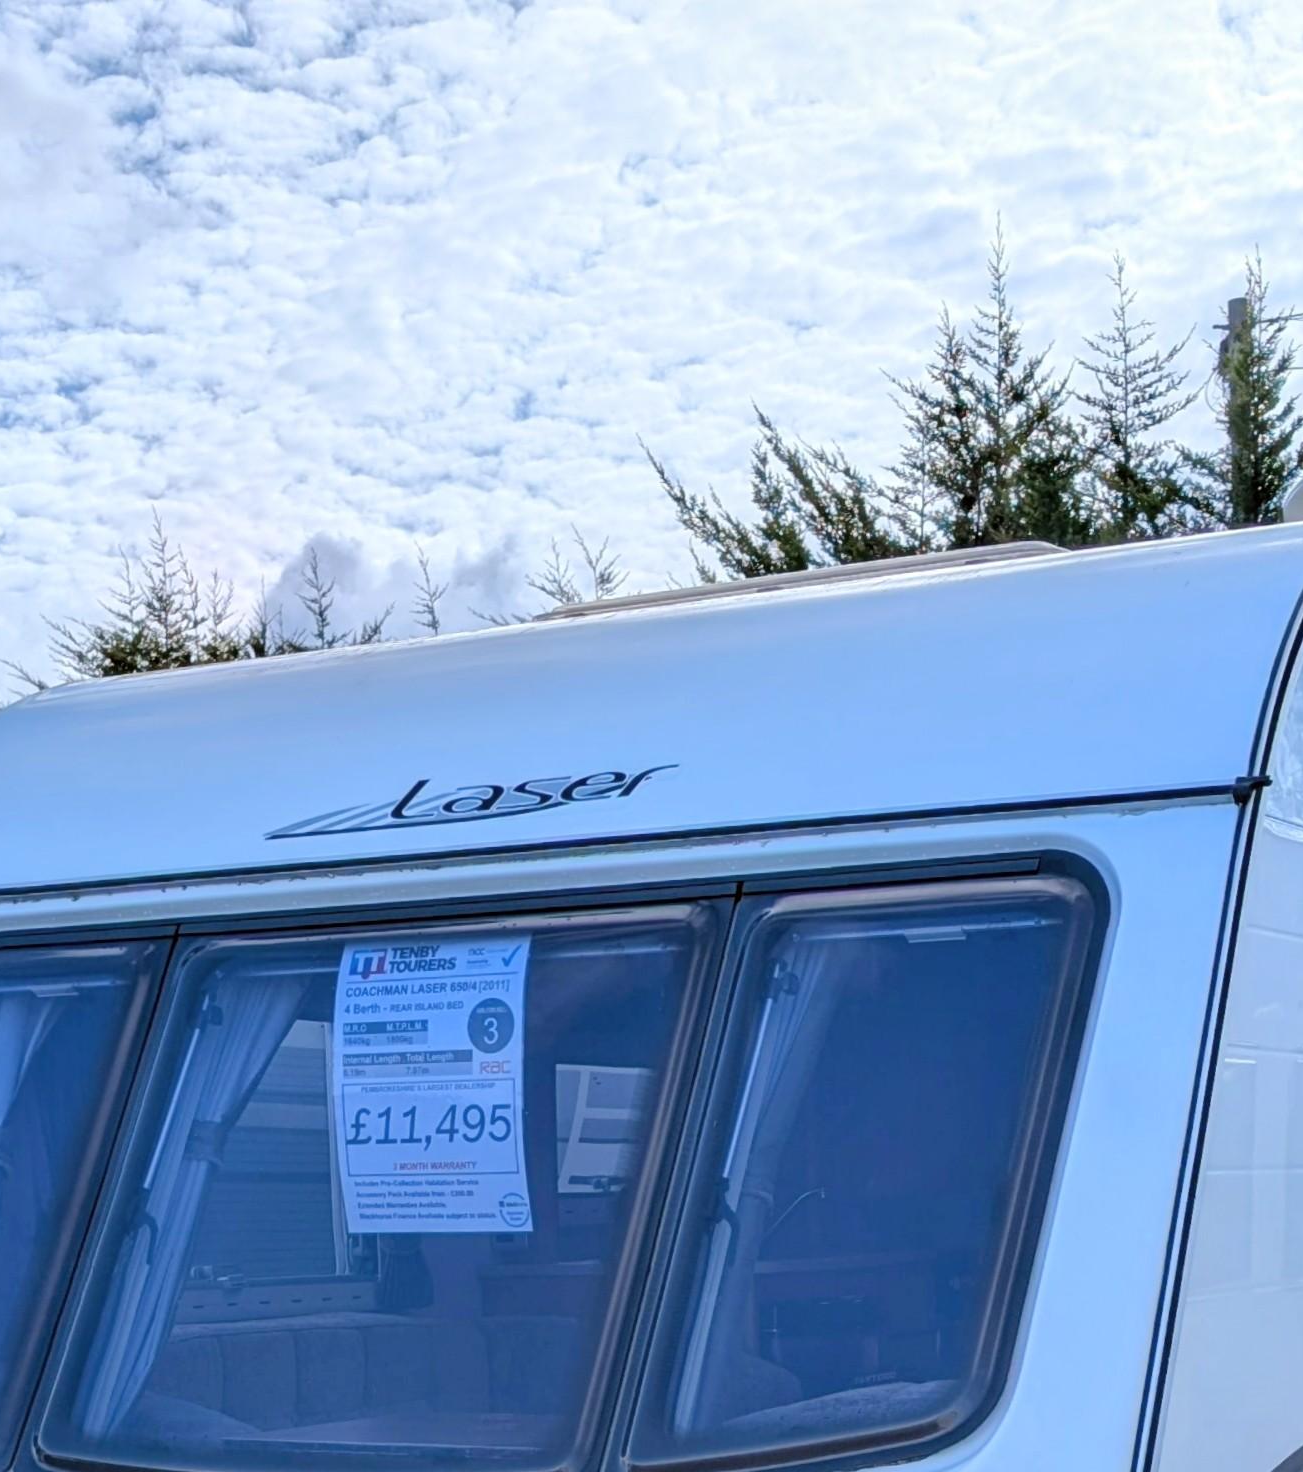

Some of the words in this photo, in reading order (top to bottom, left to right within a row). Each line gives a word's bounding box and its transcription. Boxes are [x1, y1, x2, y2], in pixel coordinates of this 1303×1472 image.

[390, 764, 679, 819] Laser
[392, 945, 440, 959] TENBY
[389, 957, 457, 973] TOURERS
[346, 984, 408, 998] COACHMAN
[411, 982, 447, 995] LASER
[354, 1003, 381, 1014] Berth
[390, 1004, 413, 1012] REAR
[446, 1000, 464, 1010] BED
[484, 1017, 499, 1045] 3
[347, 1104, 511, 1151] £11,495
